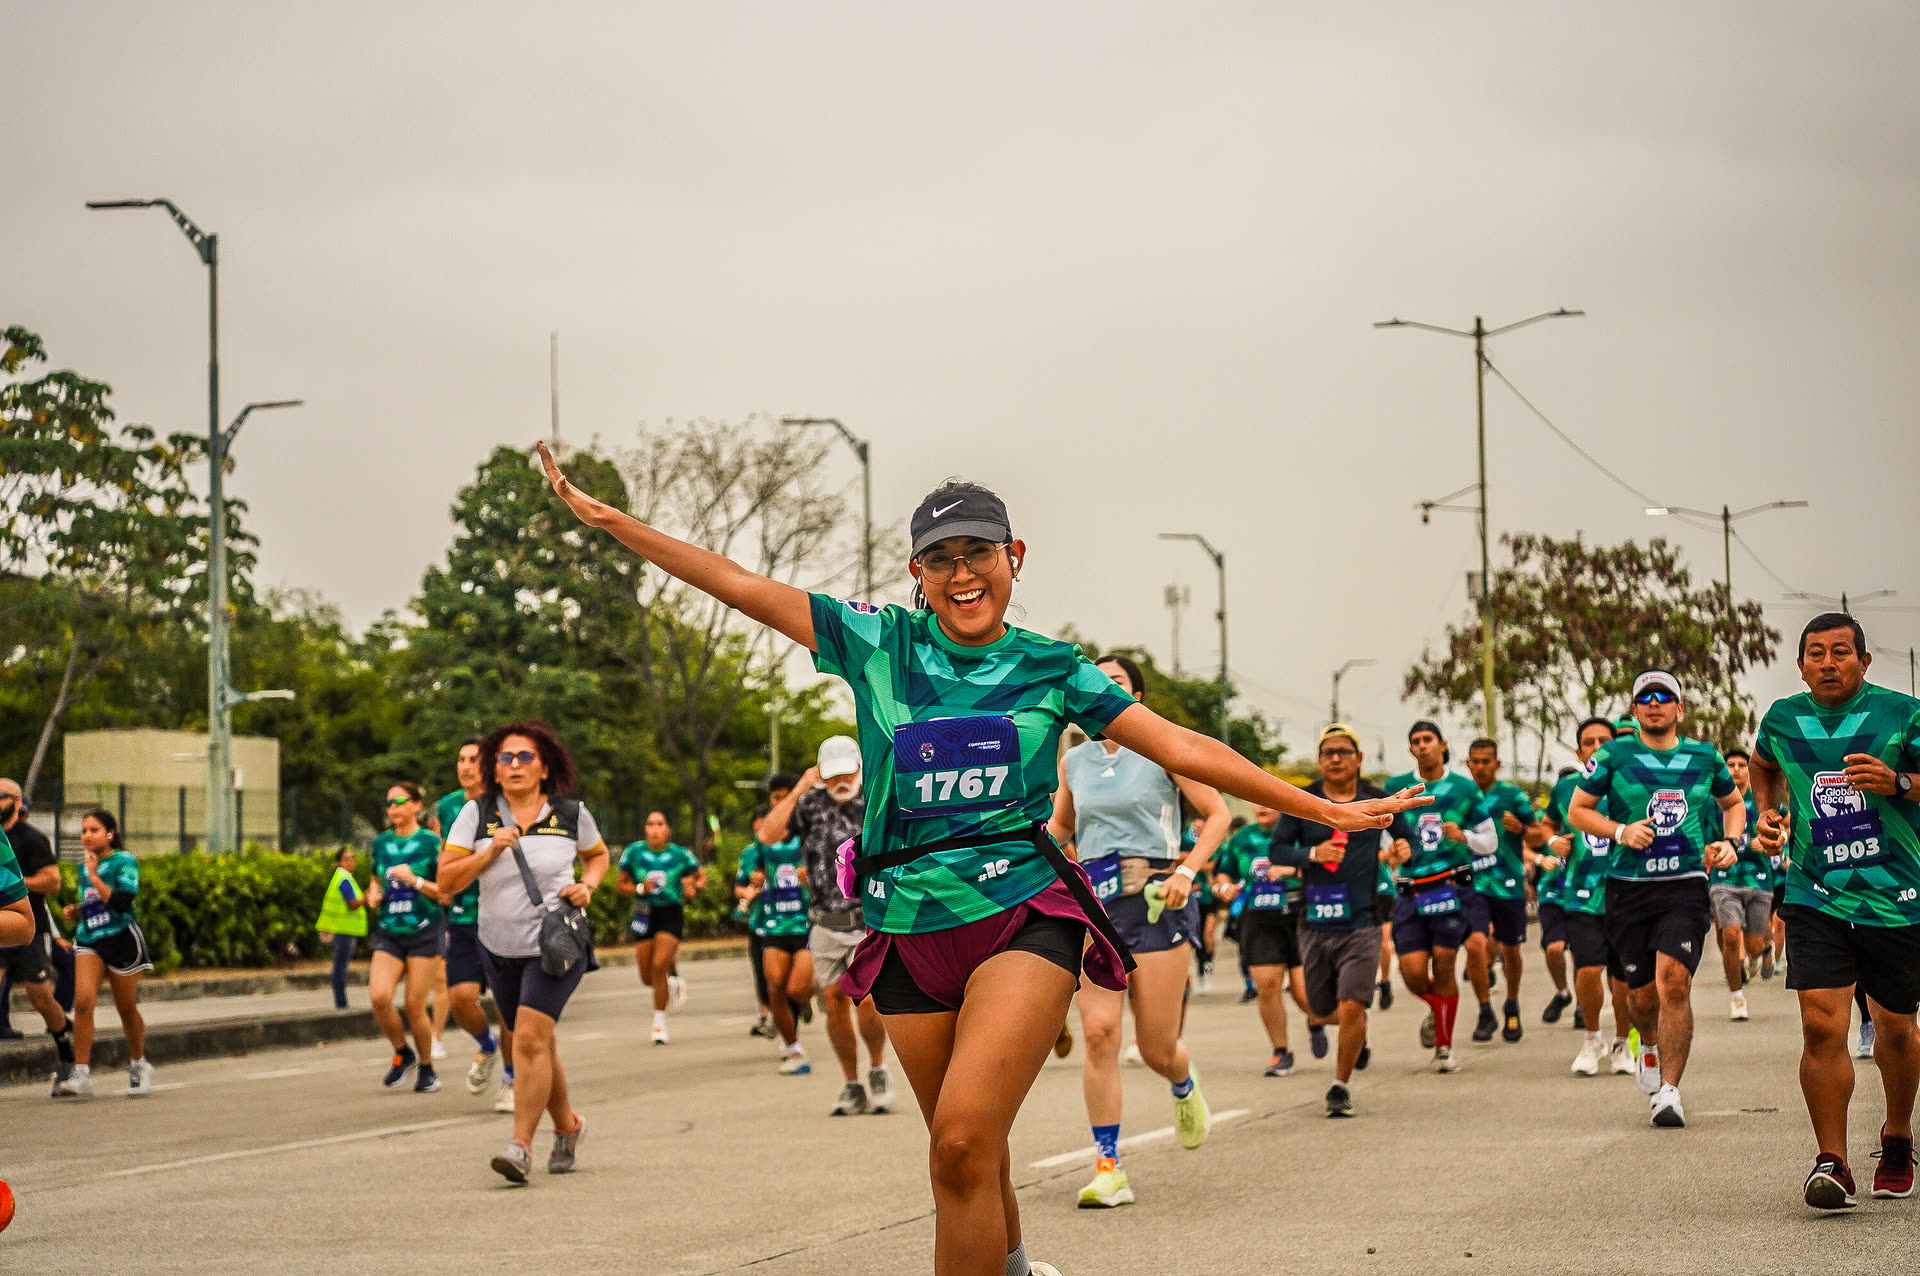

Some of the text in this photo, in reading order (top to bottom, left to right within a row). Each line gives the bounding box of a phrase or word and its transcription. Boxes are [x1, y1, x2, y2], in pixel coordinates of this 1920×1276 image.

[915, 765, 1009, 803] 1767
[1820, 794, 1844, 804] Race
[1823, 837, 1880, 864] 1903
[1646, 856, 1680, 872] 686
[1315, 903, 1344, 918] 703
